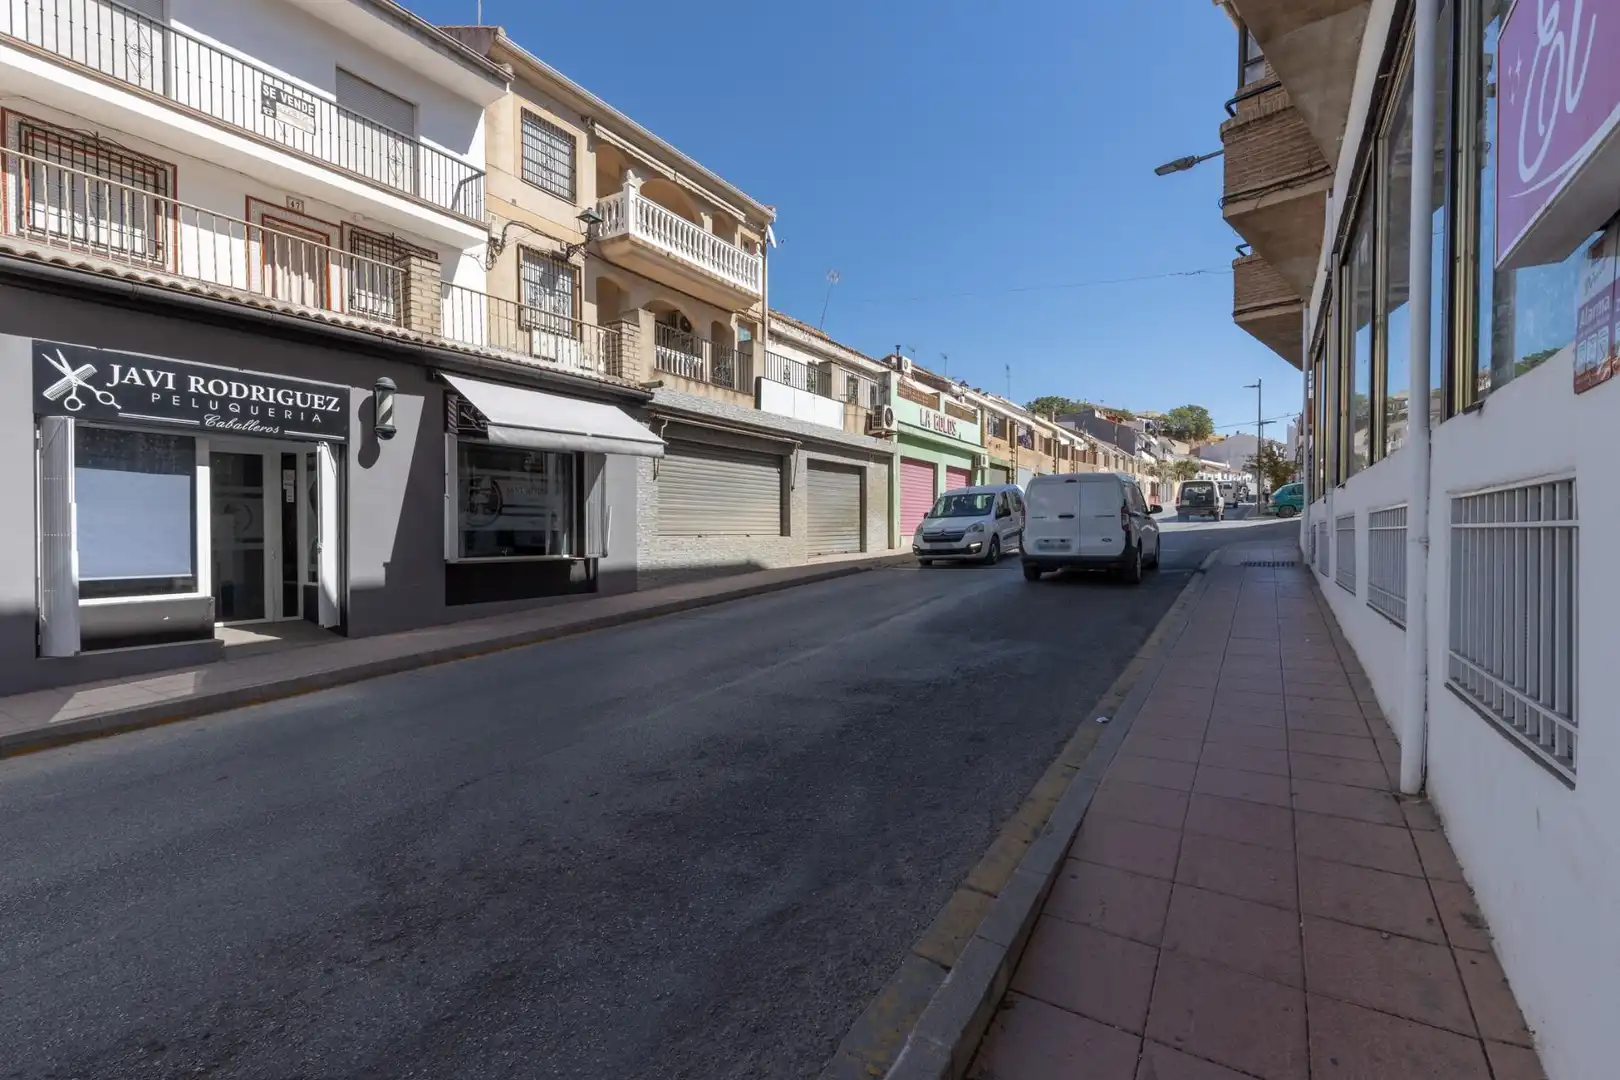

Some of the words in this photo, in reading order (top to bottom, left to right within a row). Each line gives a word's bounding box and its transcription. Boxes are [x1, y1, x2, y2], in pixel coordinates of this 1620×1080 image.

[262, 84, 277, 99] SE
[280, 92, 315, 116] VENDE
[290, 200, 301, 210] 47
[107, 364, 175, 390] JAVI
[187, 375, 341, 413] RODRIGUEZ
[151, 392, 322, 424] PELUQUERIA
[920, 408, 931, 428] LA
[203, 413, 280, 434] Caballeros
